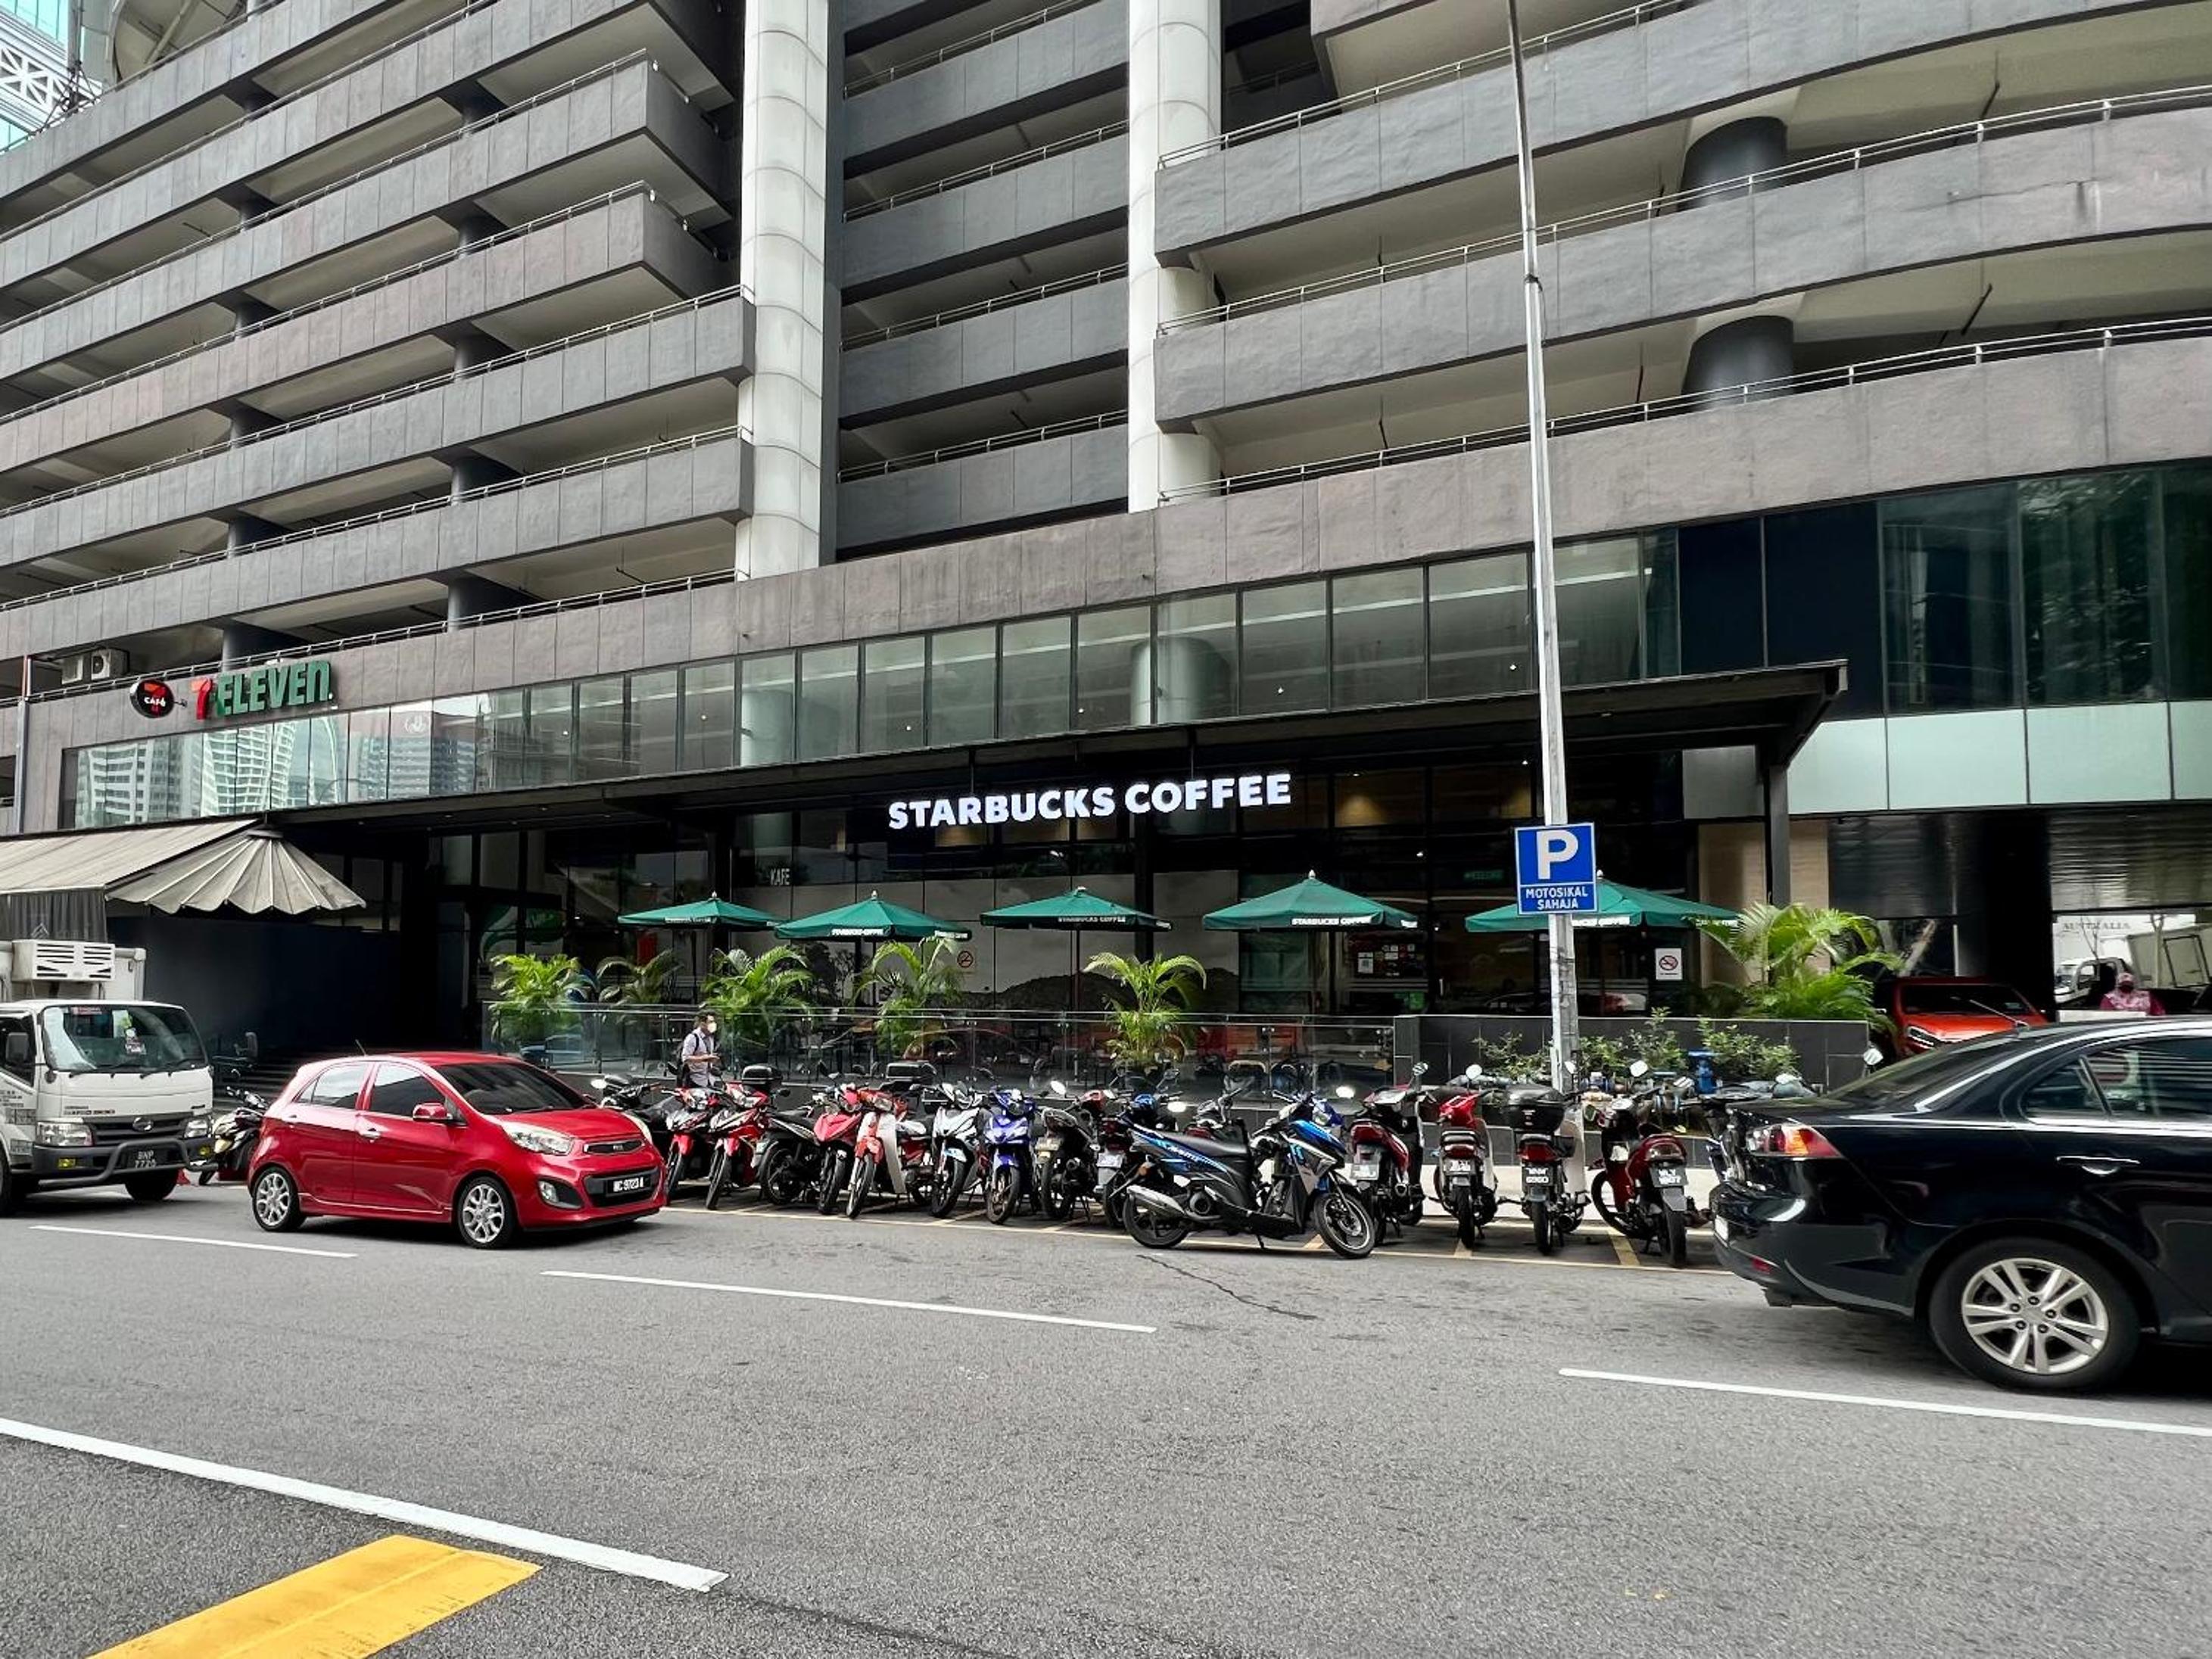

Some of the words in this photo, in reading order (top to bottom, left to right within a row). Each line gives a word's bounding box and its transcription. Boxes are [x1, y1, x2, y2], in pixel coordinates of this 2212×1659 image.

[888, 787, 1115, 830] STARBUCKS
[1125, 773, 1291, 814] COFFEE
[1536, 830, 1578, 879] P
[1525, 886, 1589, 899] MOTOSIKAL
[1537, 898, 1578, 910] SAHAJA
